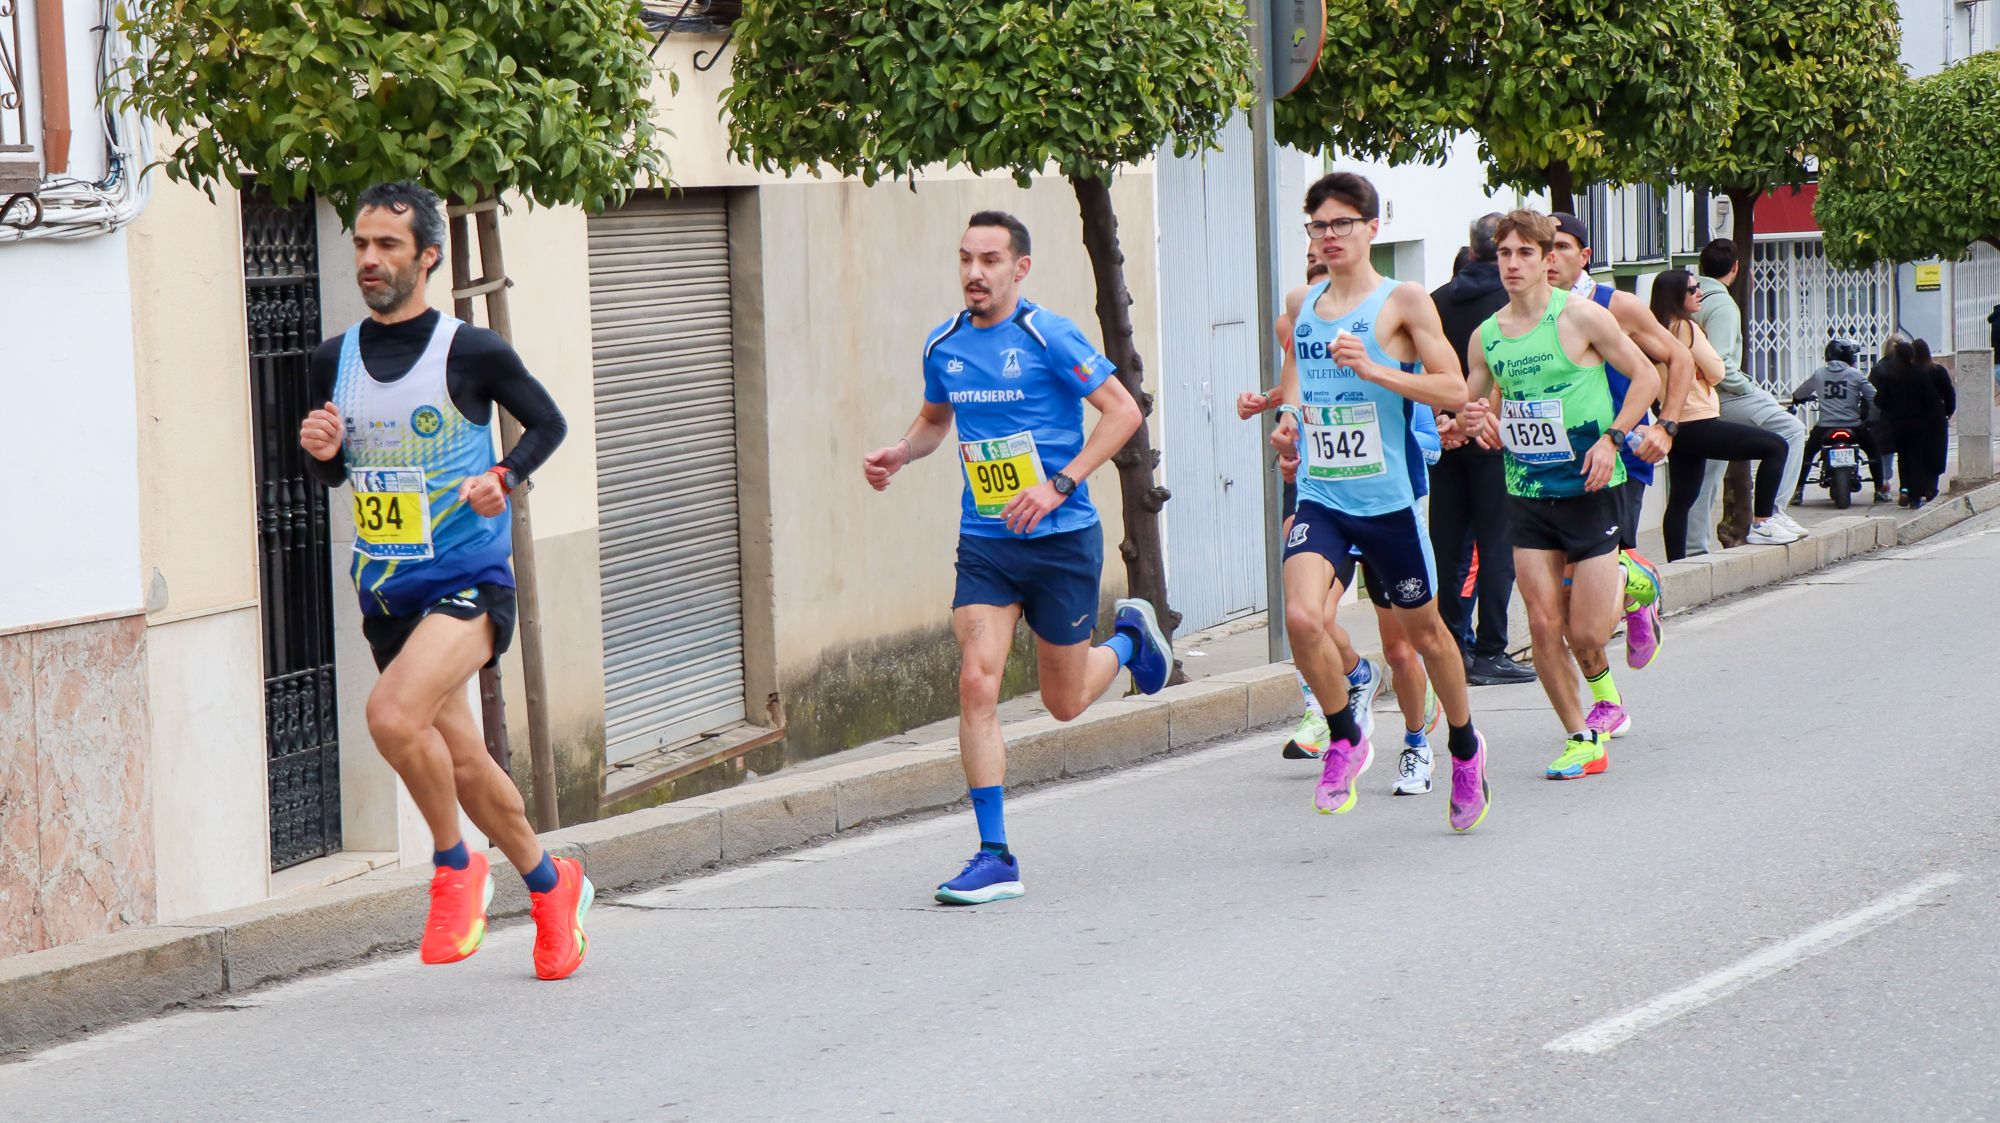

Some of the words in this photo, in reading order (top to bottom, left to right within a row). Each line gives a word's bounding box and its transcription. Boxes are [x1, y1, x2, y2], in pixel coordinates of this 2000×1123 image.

[1507, 352, 1554, 369] Fundación
[1306, 368, 1356, 380] ATLETISMO
[1508, 364, 1542, 378] Unicaja
[948, 389, 1026, 404] TROTASIERRA
[1506, 423, 1557, 447] 1529
[1312, 430, 1368, 460] 1542
[977, 462, 1021, 494] 909
